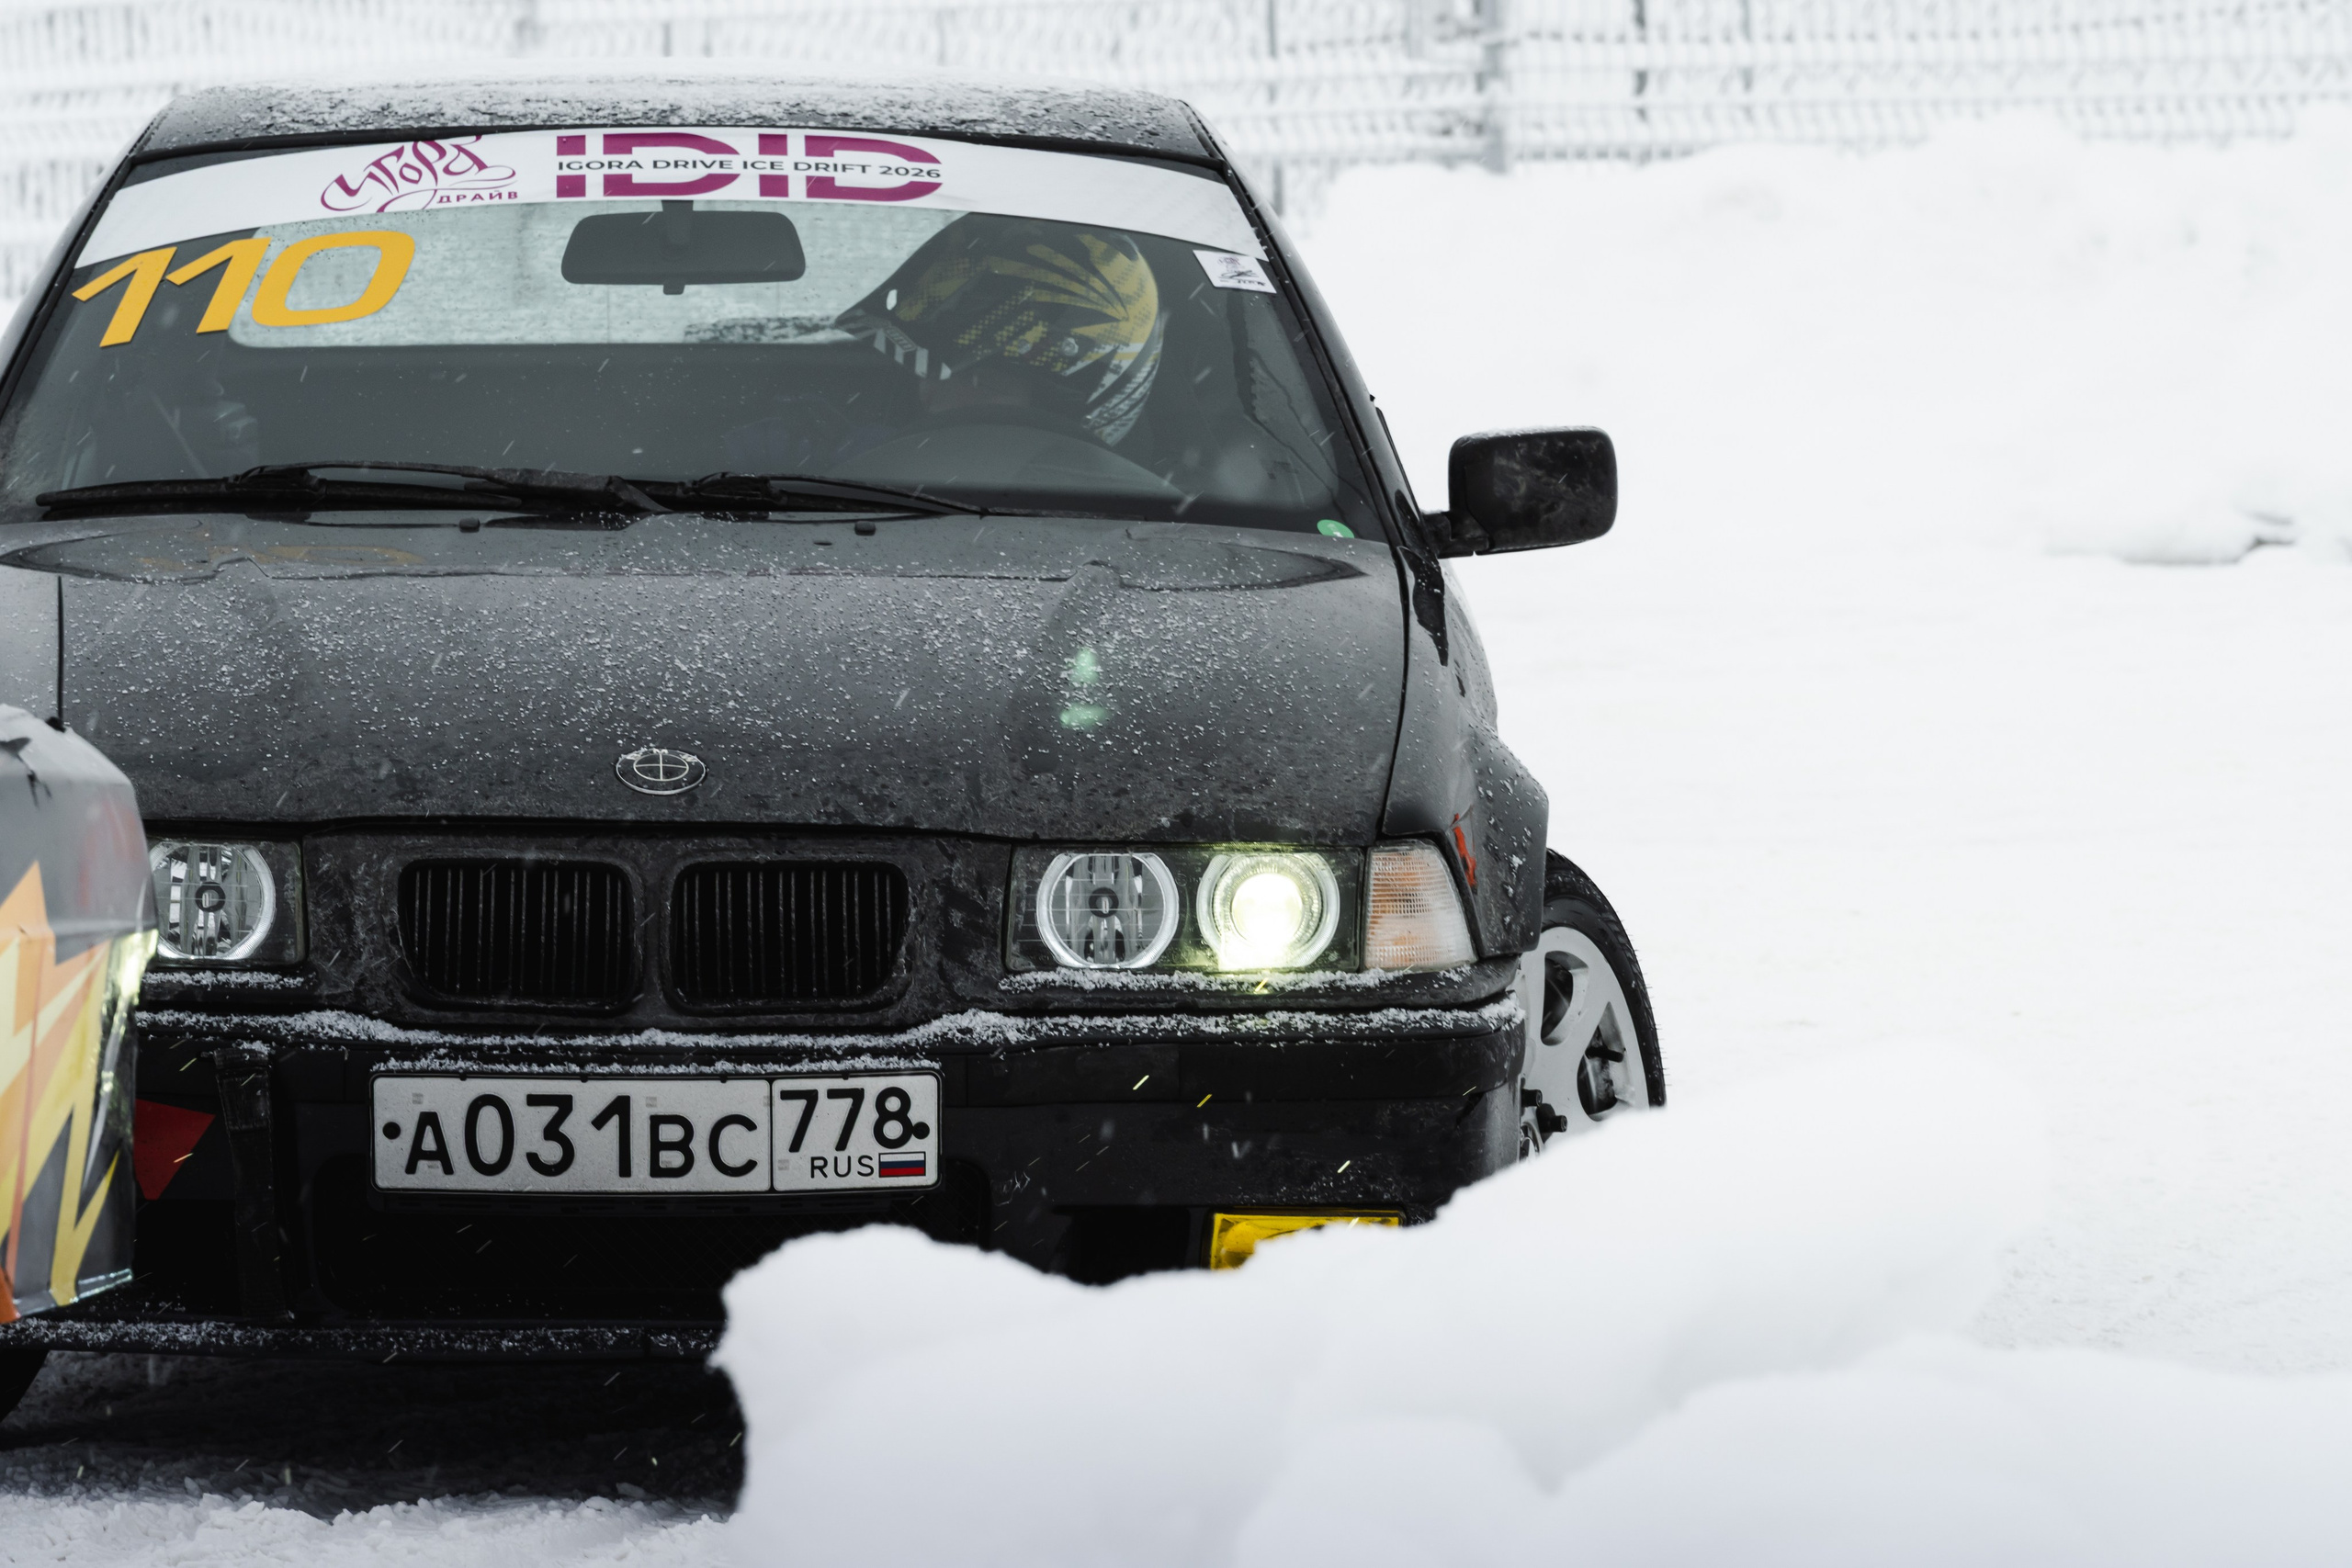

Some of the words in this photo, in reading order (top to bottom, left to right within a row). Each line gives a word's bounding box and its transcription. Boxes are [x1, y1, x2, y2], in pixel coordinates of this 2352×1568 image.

[558, 160, 644, 171] IGORA
[652, 159, 734, 170] DRIVE
[742, 160, 785, 171] ICE
[793, 161, 872, 174] DRIFT
[878, 165, 942, 178] 2026
[436, 189, 519, 204] ДРАЙВ
[71, 230, 416, 348] 110
[778, 1086, 914, 1153] 778
[810, 1155, 875, 1179] RUS
